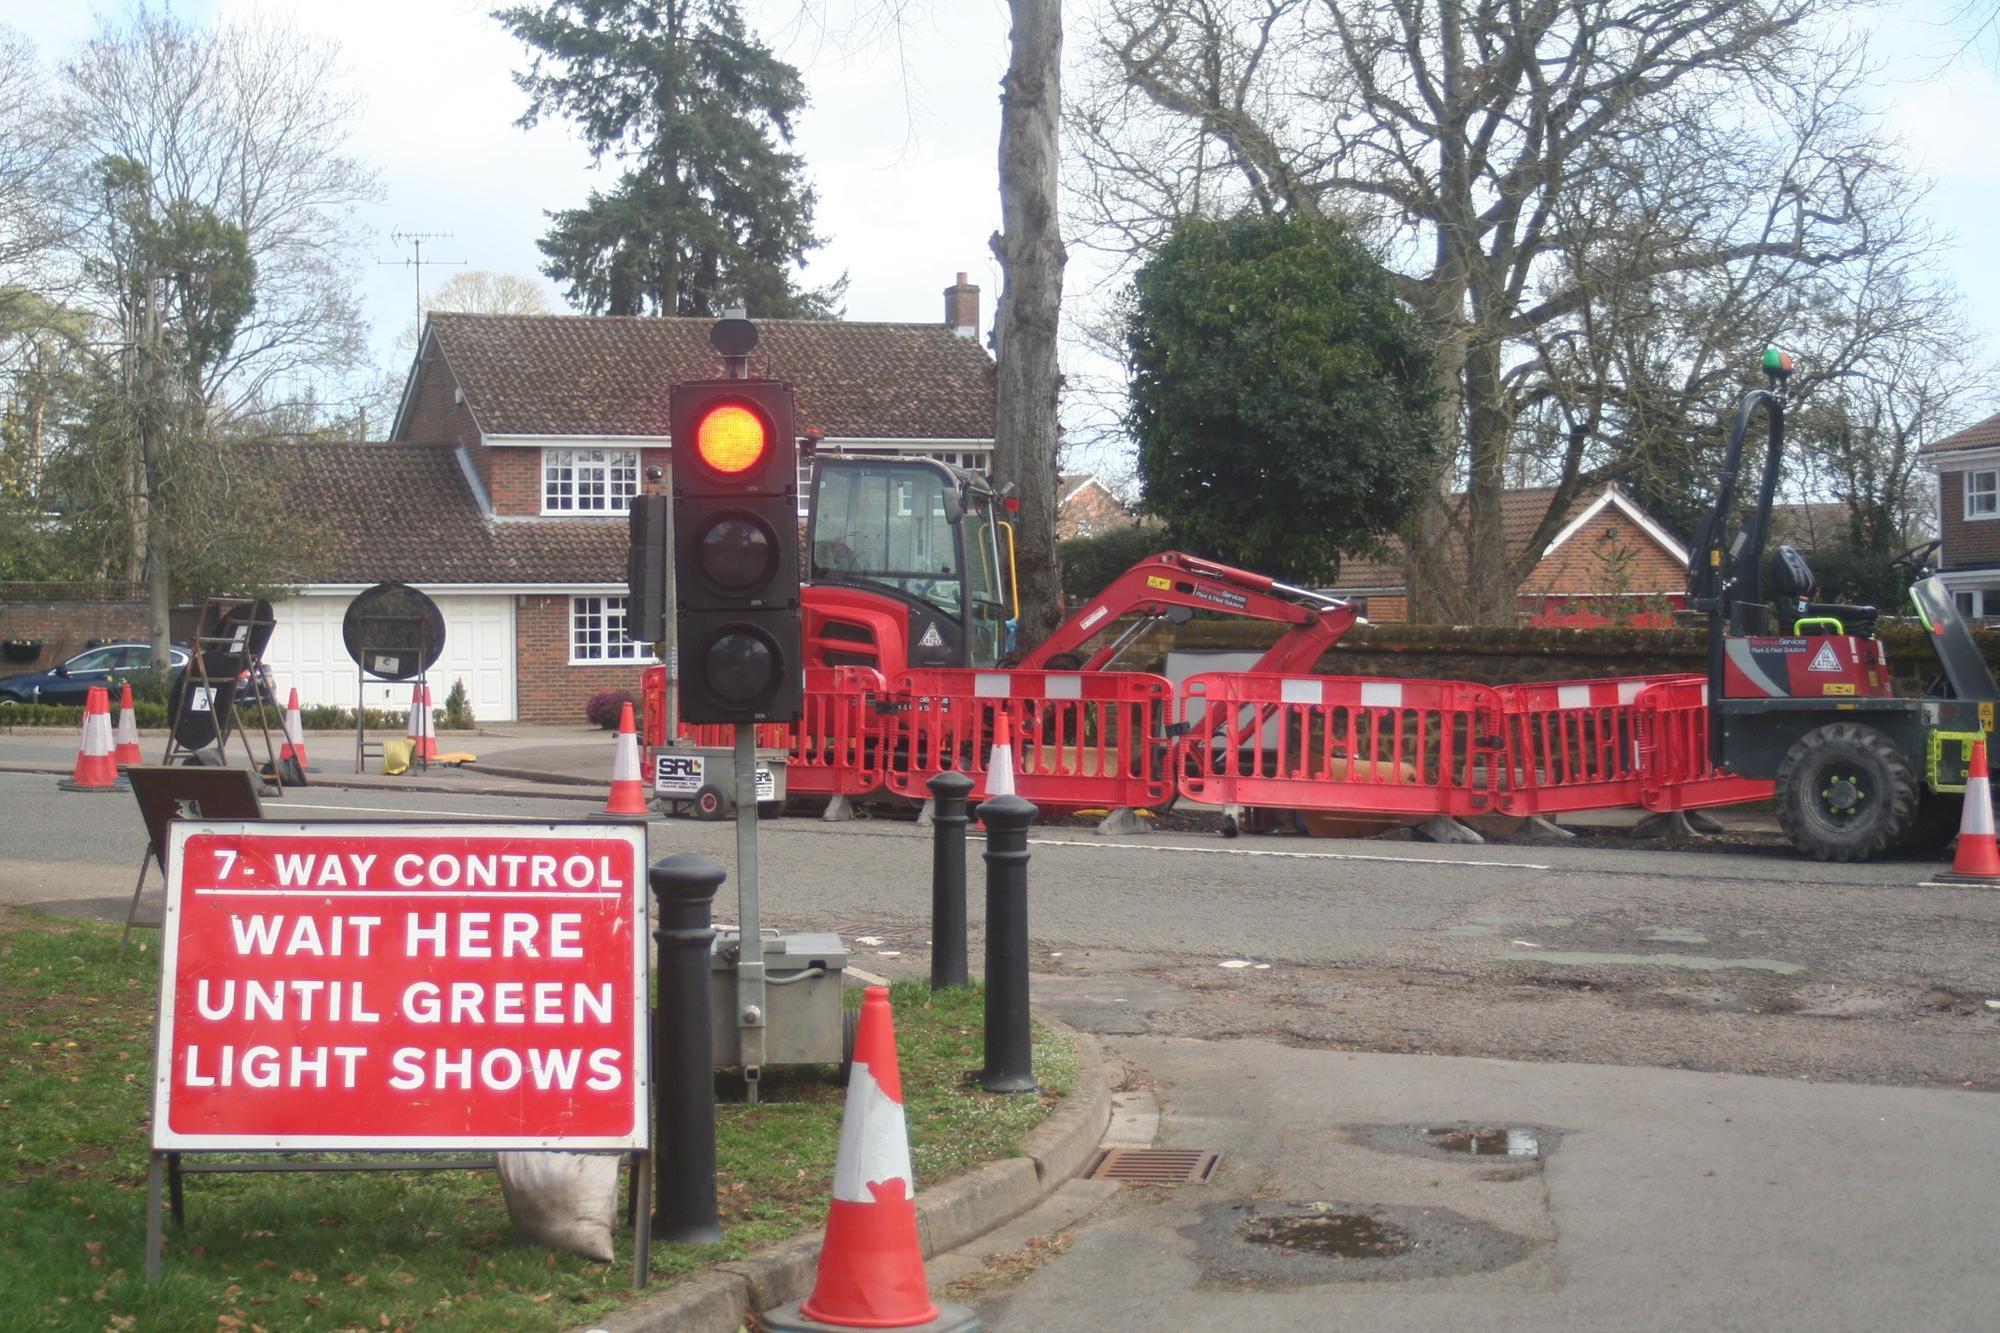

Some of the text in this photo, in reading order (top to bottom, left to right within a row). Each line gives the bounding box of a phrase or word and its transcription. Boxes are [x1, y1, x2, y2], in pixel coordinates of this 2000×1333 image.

[659, 758, 701, 776] SRL
[276, 854, 377, 887] WAY
[394, 854, 623, 888] CONTROL
[231, 912, 583, 958] WAIT HERE
[198, 980, 613, 1024] UNTIL GREEN
[186, 1045, 622, 1091] LIGHT SHOWS
